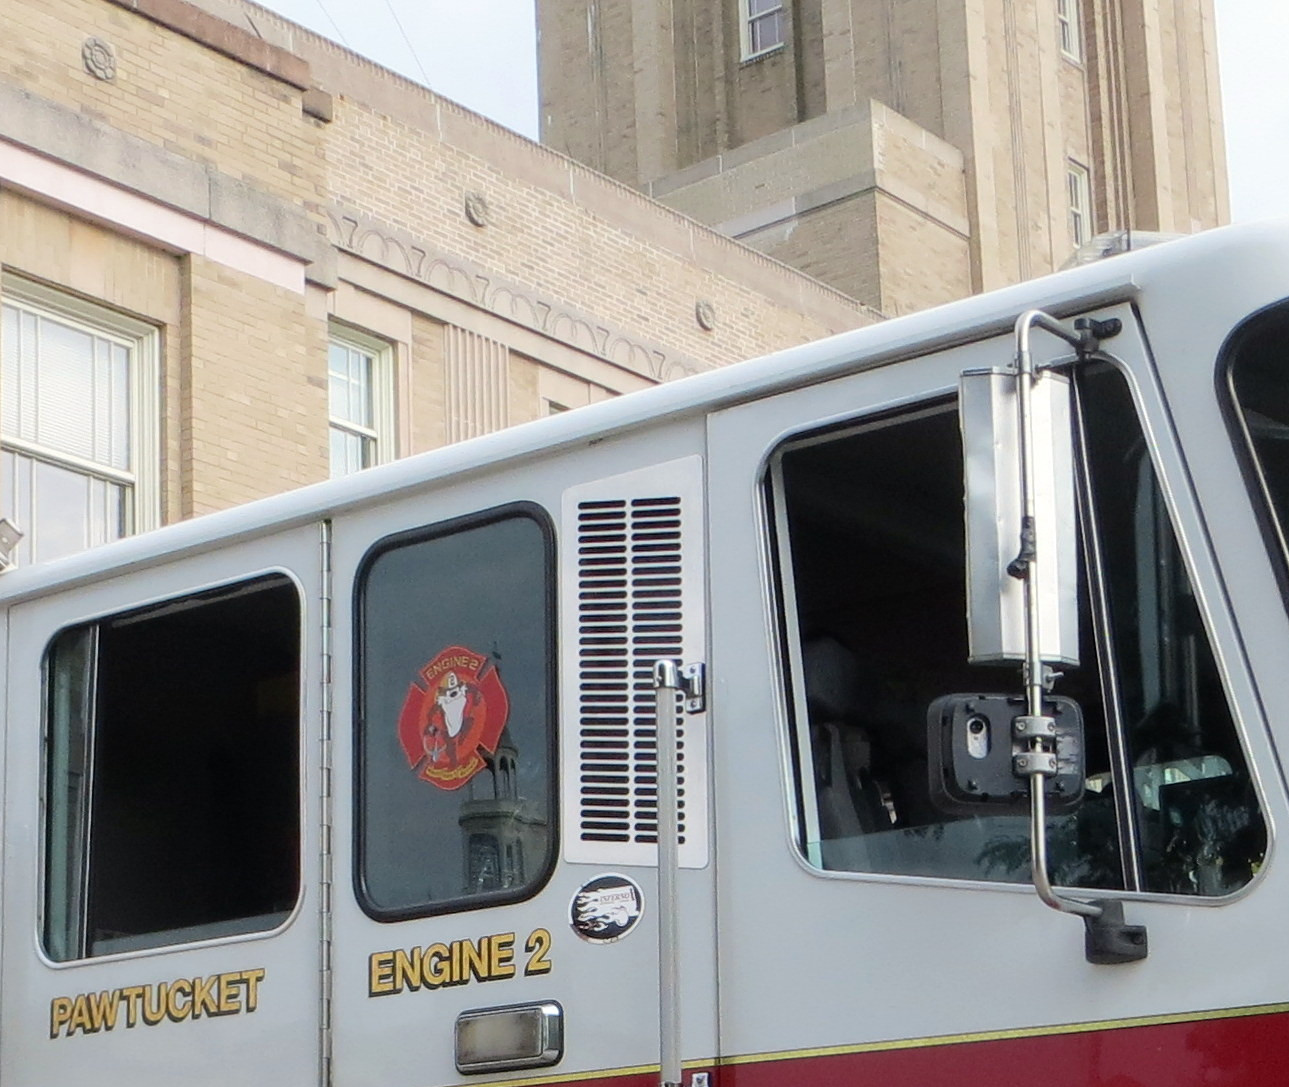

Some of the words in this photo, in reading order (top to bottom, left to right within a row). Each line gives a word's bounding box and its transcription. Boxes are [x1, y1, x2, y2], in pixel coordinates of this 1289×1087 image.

[425, 656, 469, 680] ENGINE
[468, 659, 479, 671] 2
[368, 931, 518, 998] ENGINE
[524, 927, 553, 977] 2
[49, 968, 265, 1039] PAWTUCKET
